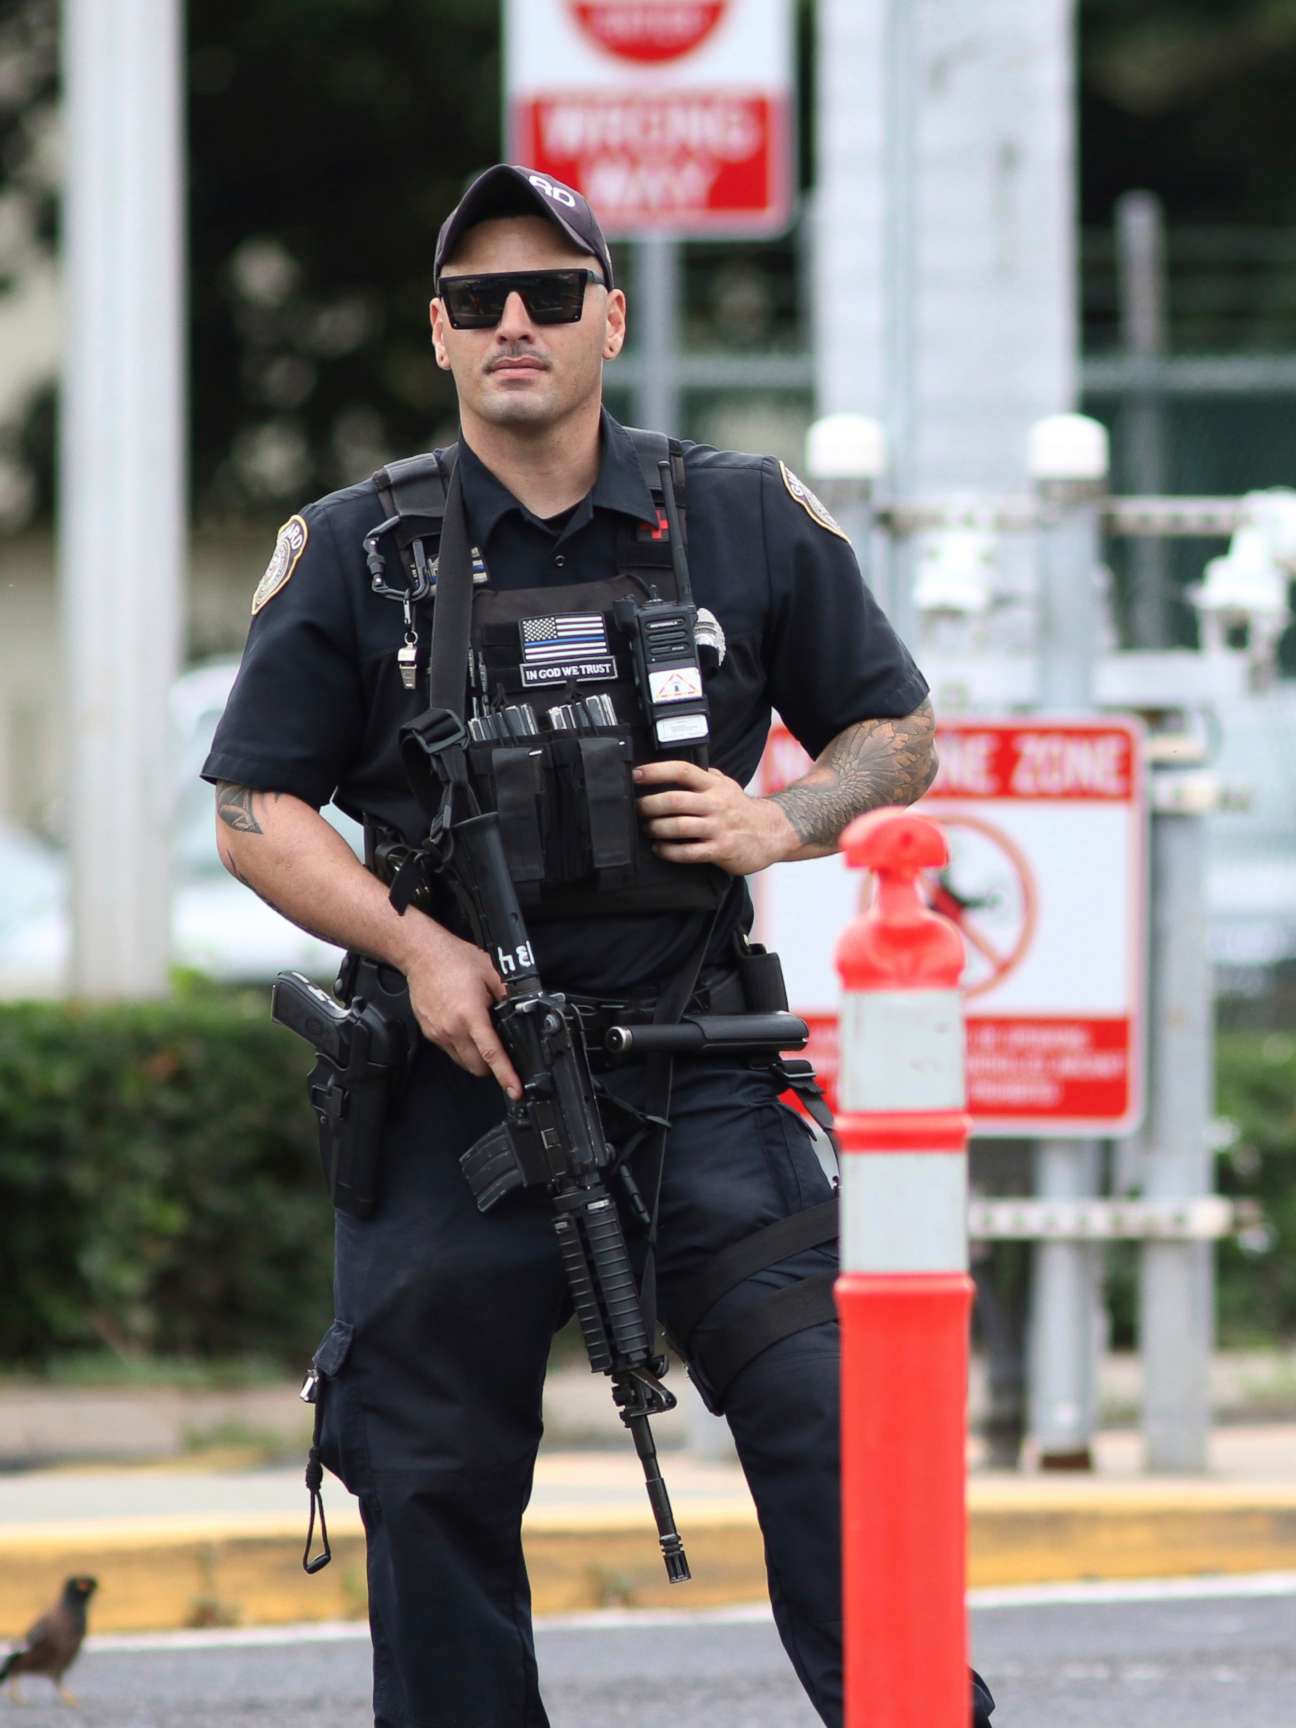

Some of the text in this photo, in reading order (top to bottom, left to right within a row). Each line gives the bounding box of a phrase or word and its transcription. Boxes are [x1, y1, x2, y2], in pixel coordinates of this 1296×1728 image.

[545, 102, 763, 159] WRONG
[583, 157, 719, 208] WAY
[525, 663, 612, 680] IN GOD WE TRUST
[1012, 733, 1124, 794] ZONE
